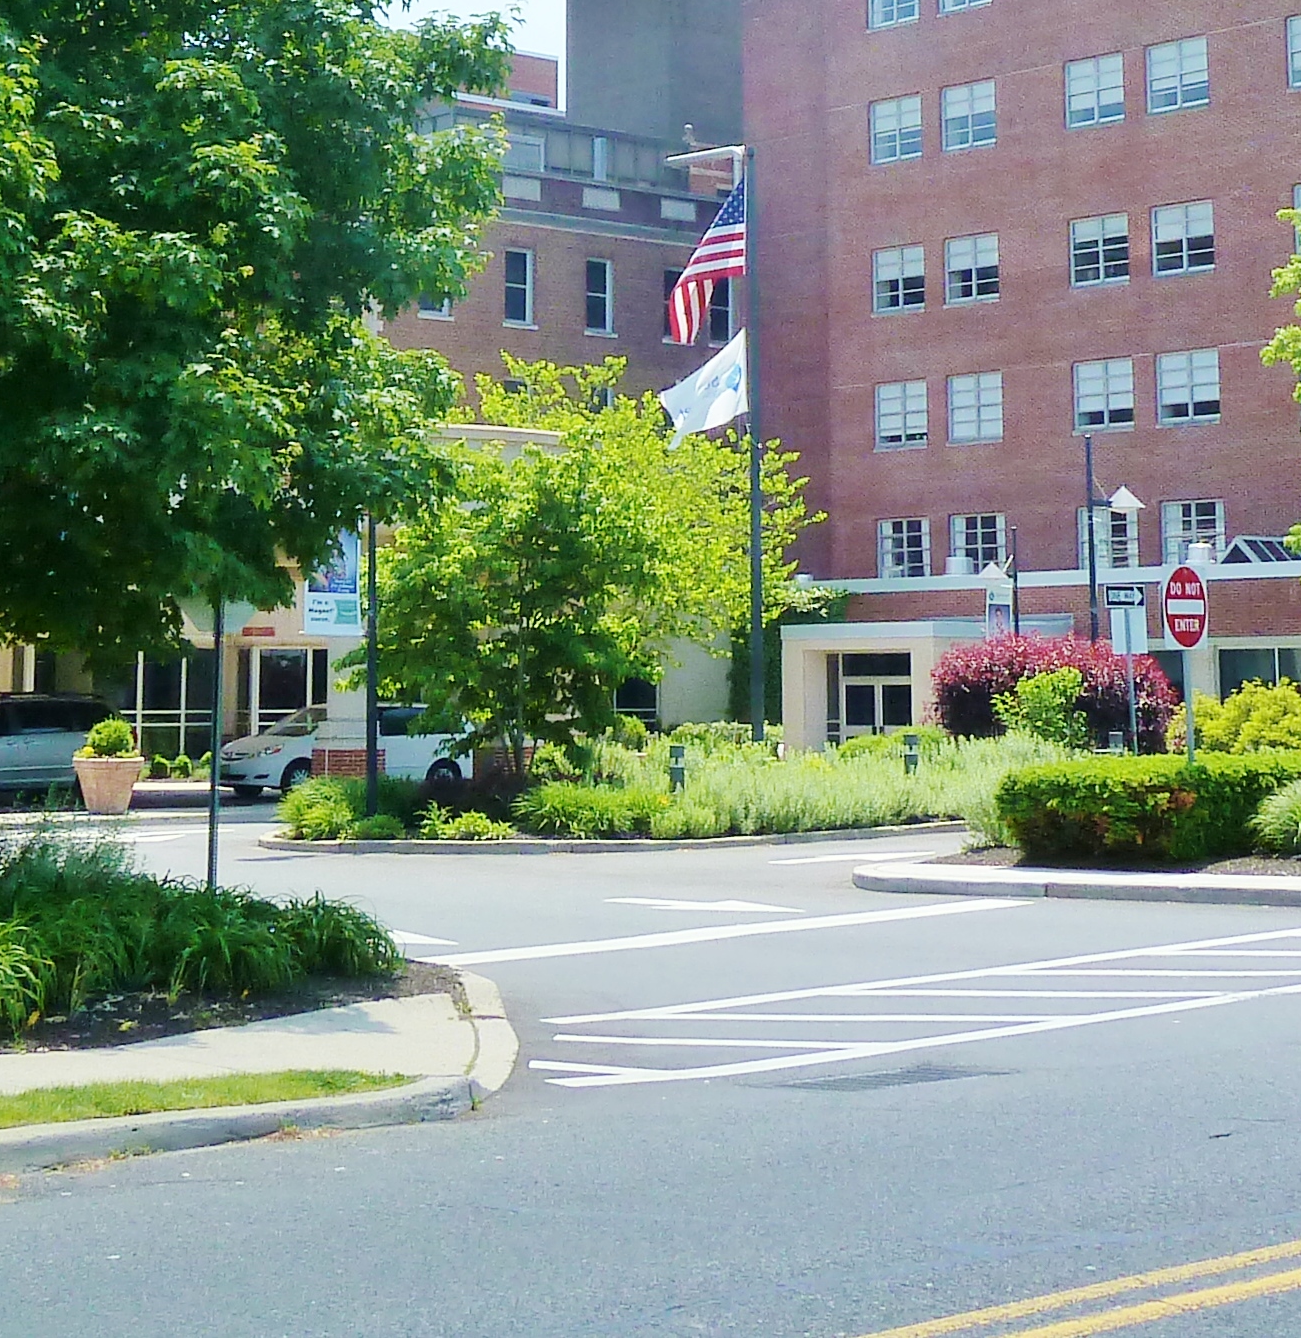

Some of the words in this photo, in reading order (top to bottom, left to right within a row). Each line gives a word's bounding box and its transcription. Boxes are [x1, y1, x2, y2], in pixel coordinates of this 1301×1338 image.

[1170, 582, 1182, 595] DO
[1185, 582, 1201, 596] NOT
[1175, 619, 1200, 632] ENTER
